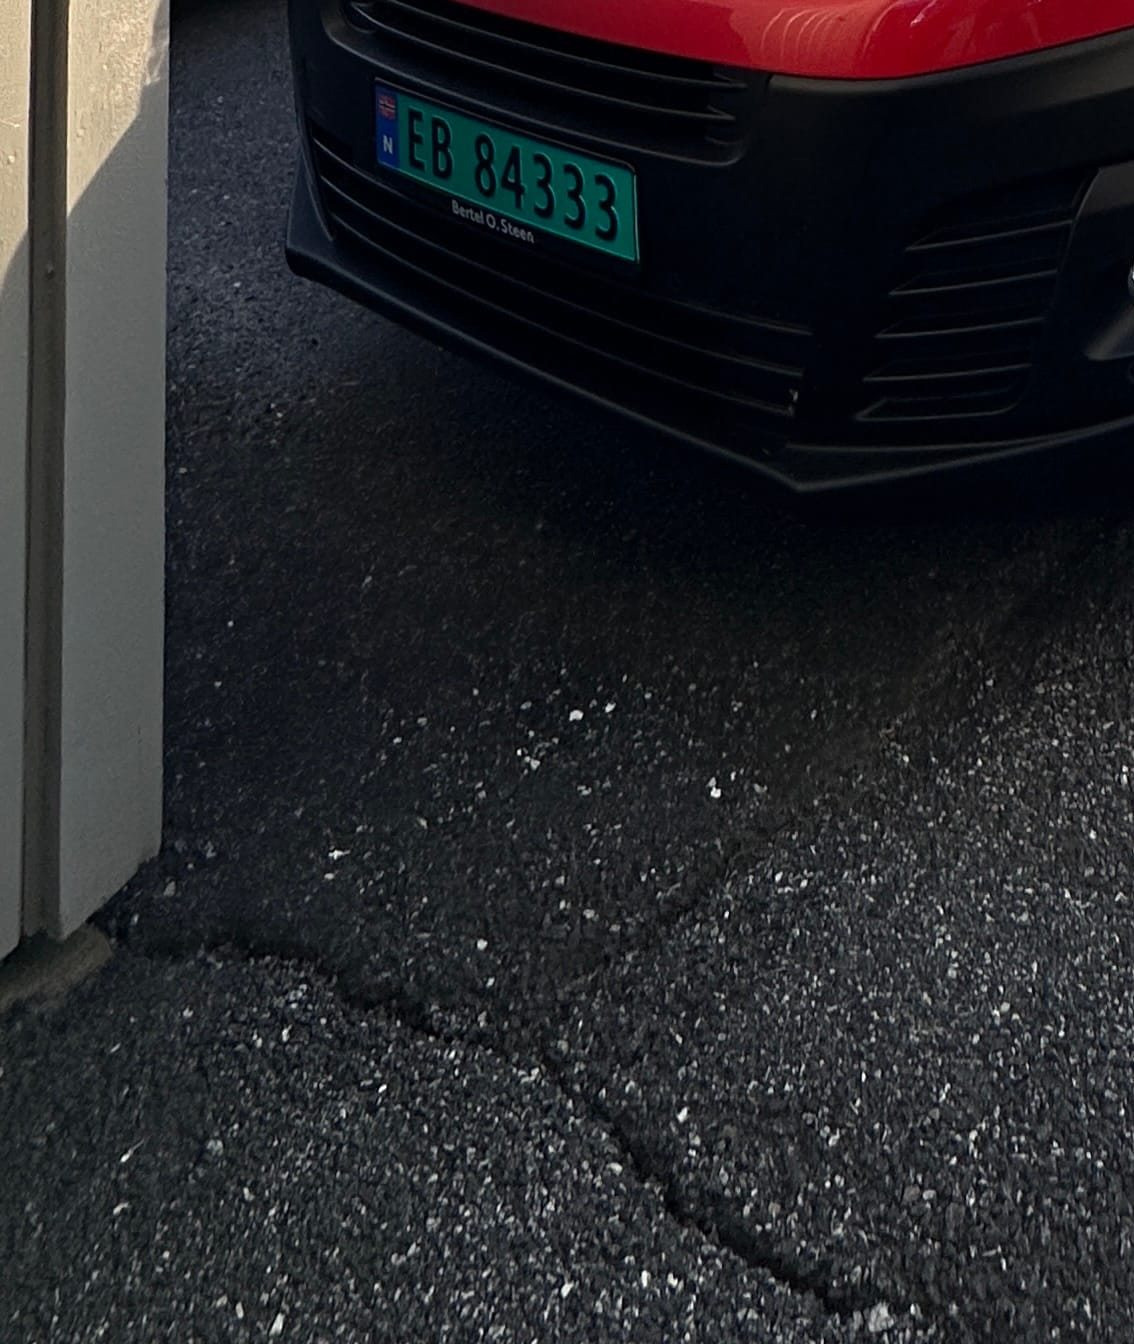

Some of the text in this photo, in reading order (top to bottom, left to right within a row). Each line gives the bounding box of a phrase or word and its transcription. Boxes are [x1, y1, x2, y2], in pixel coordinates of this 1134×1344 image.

[383, 135, 393, 155] N
[407, 106, 620, 242] EB 84333
[451, 199, 536, 245] Bertel O. Steen
